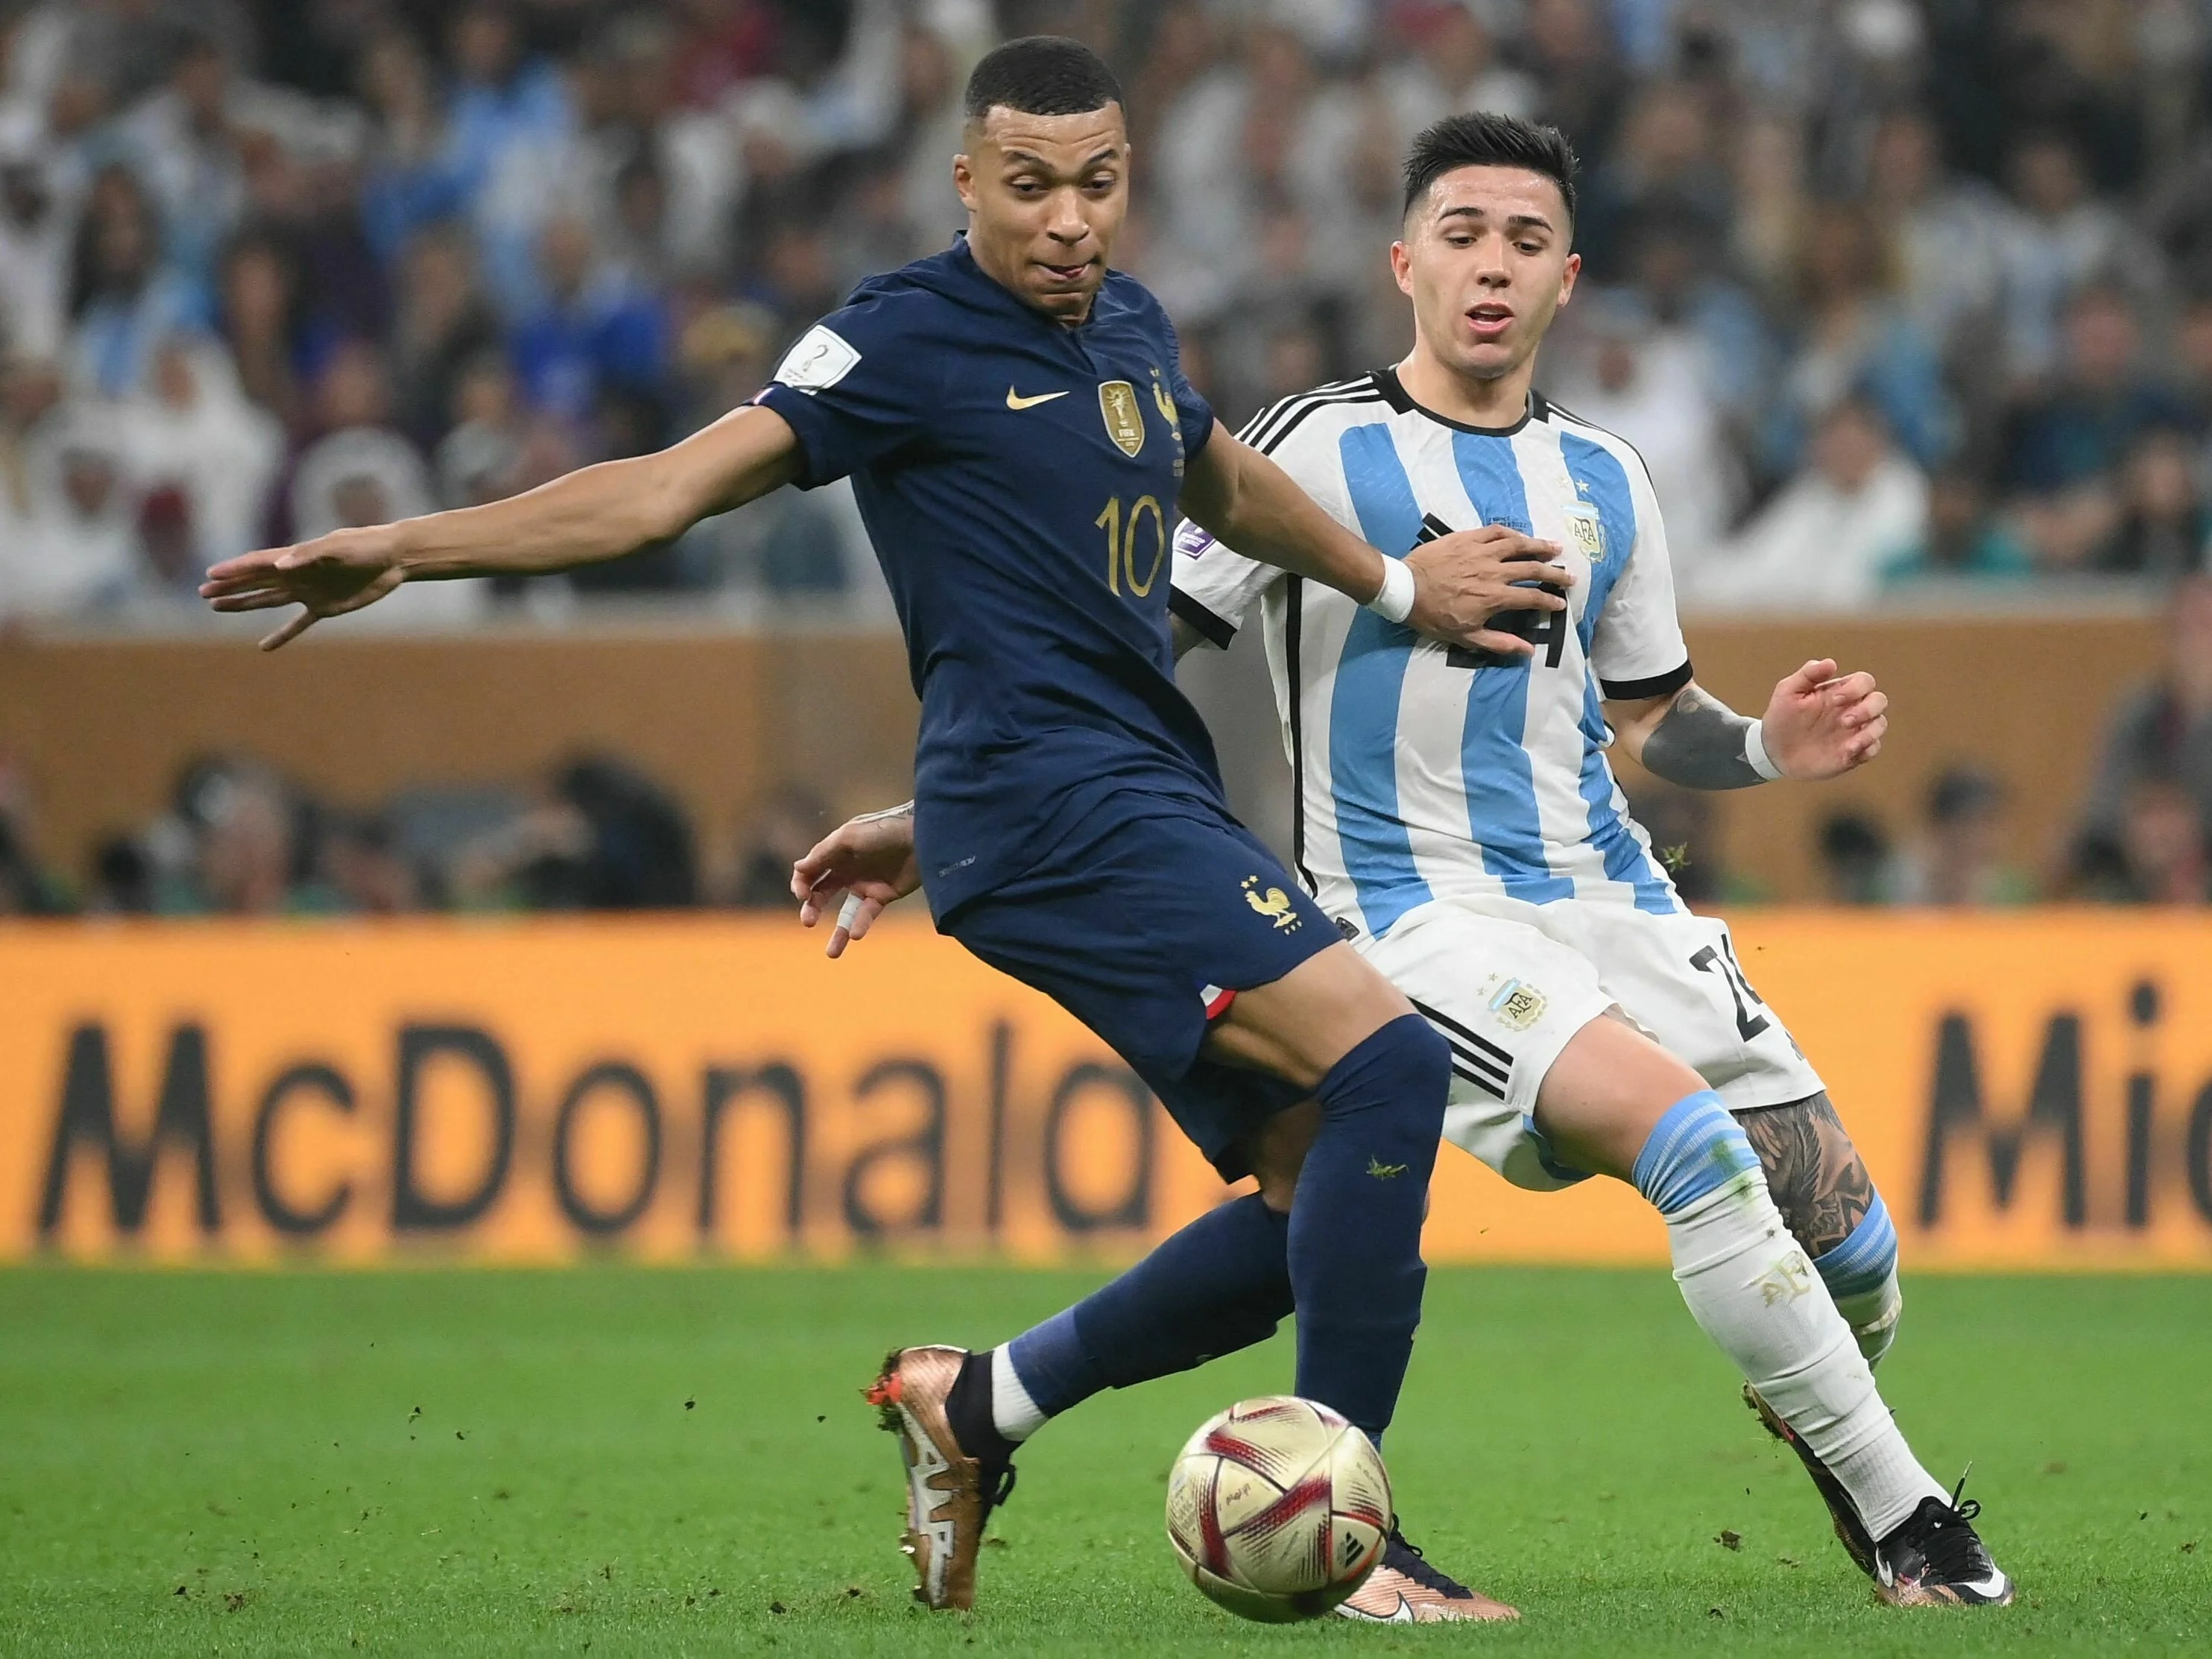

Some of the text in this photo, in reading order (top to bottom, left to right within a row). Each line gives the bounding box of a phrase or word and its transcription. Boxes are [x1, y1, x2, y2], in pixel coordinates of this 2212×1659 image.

[1094, 495, 1165, 597] 10
[1573, 516, 1596, 546] AFA
[1503, 992, 1533, 1020] AFA
